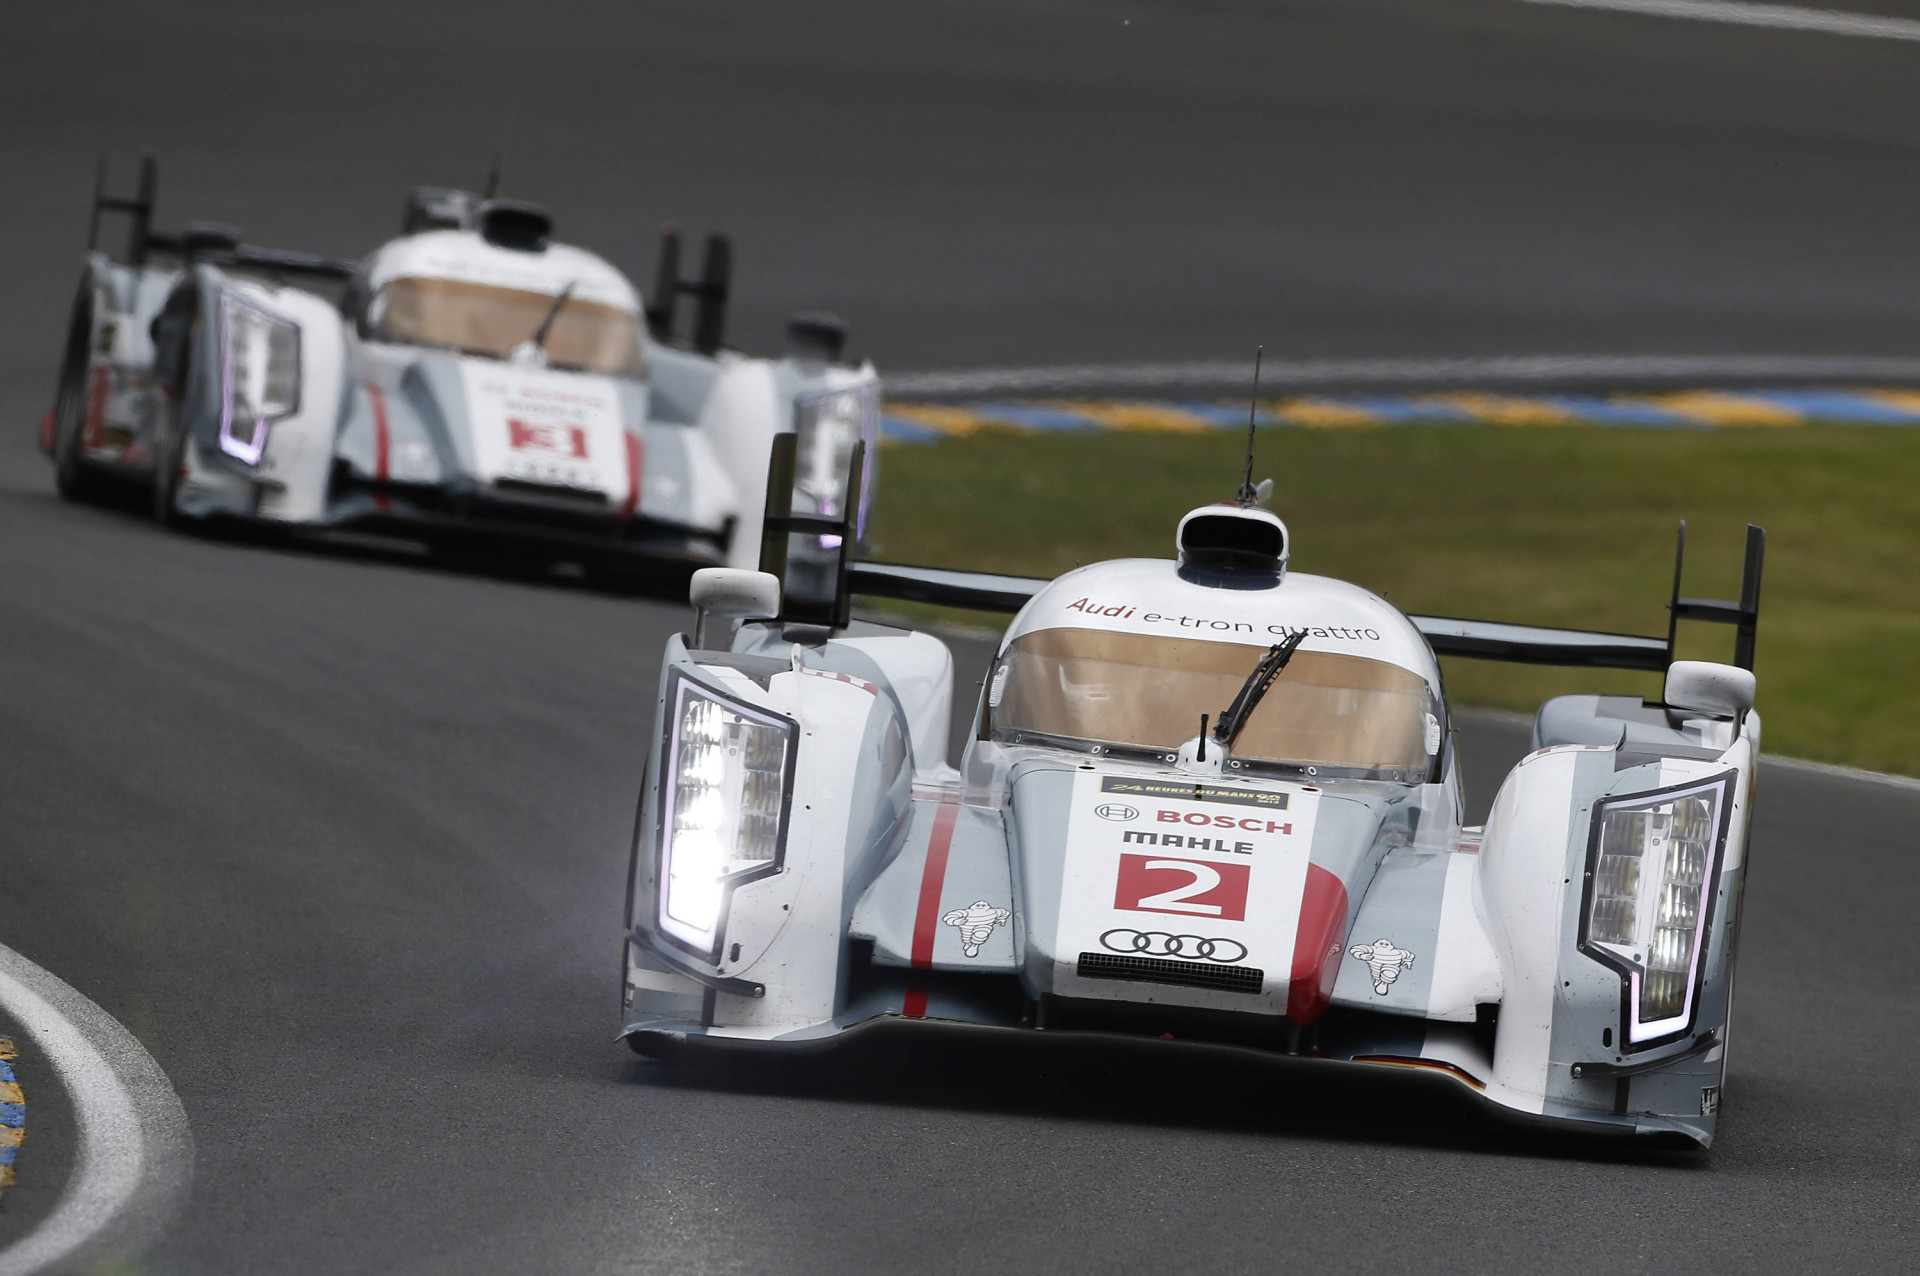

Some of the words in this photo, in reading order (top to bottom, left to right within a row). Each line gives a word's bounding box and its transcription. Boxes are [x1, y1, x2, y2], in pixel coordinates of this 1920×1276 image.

[1066, 597, 1138, 618] Audi
[1143, 612, 1254, 633] e-tron
[1145, 785, 1194, 795] HEURES
[1217, 790, 1255, 799] MANS
[1156, 810, 1293, 835] BOSCH
[1123, 830, 1254, 855] MAHLE
[1137, 859, 1223, 916] 2
